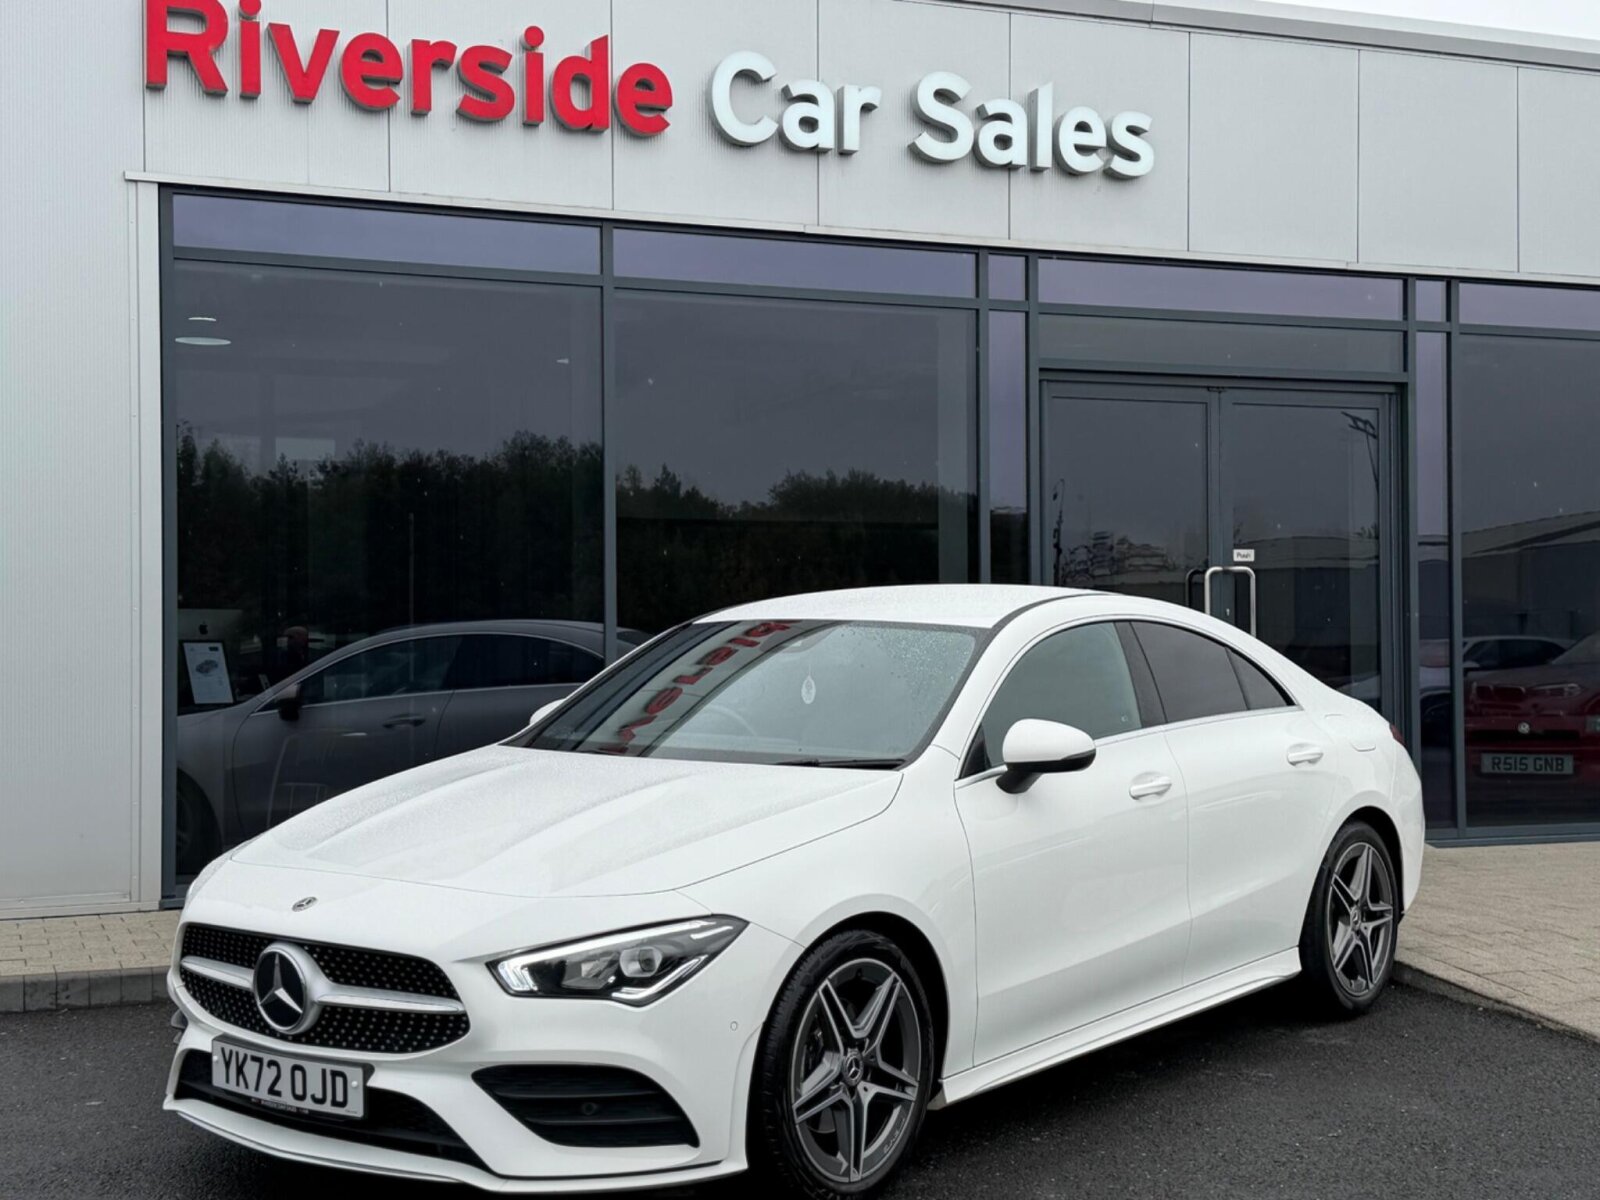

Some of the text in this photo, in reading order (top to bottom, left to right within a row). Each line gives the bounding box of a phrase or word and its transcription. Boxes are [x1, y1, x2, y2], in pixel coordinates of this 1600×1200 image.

[145, 0, 1155, 178] Riverside Car Sales
[1533, 757, 1564, 772] GNB
[221, 1047, 348, 1108] YK72 OJD
